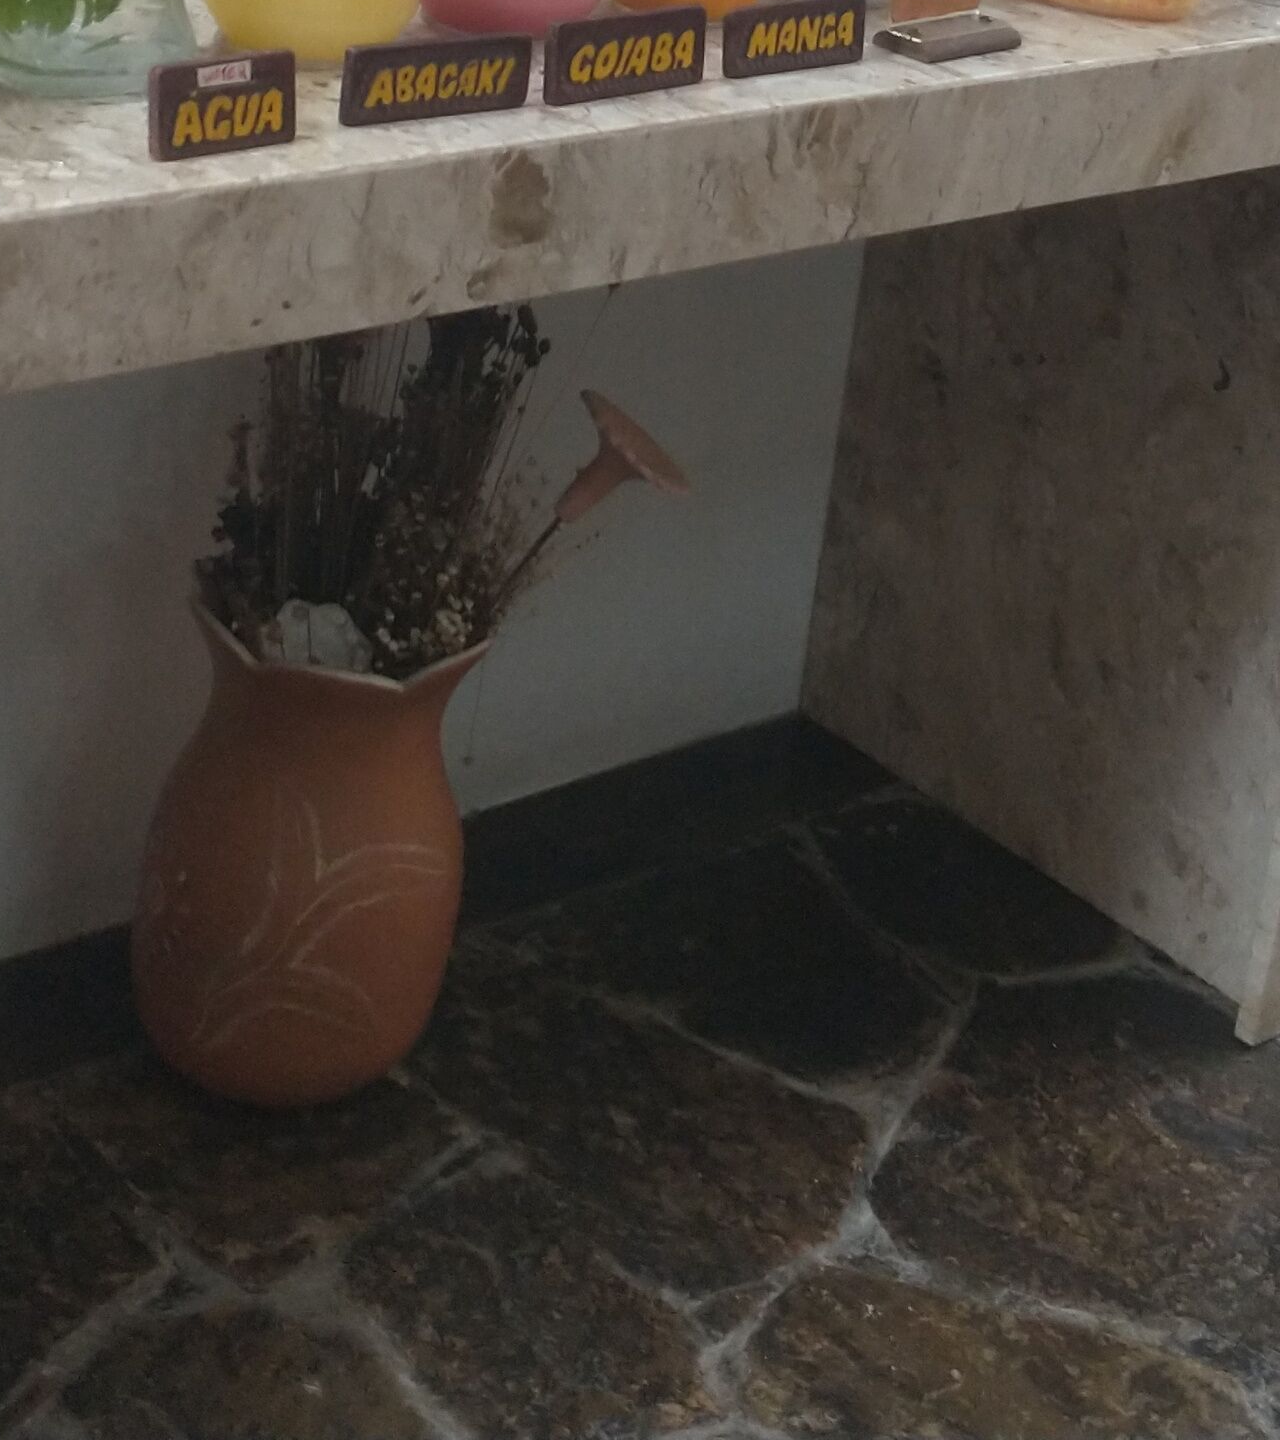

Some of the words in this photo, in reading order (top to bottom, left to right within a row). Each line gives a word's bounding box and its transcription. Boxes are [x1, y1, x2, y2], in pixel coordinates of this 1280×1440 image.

[570, 30, 696, 84] GOIABA
[747, 11, 855, 59] MANGA
[172, 87, 284, 148] ÁGUA
